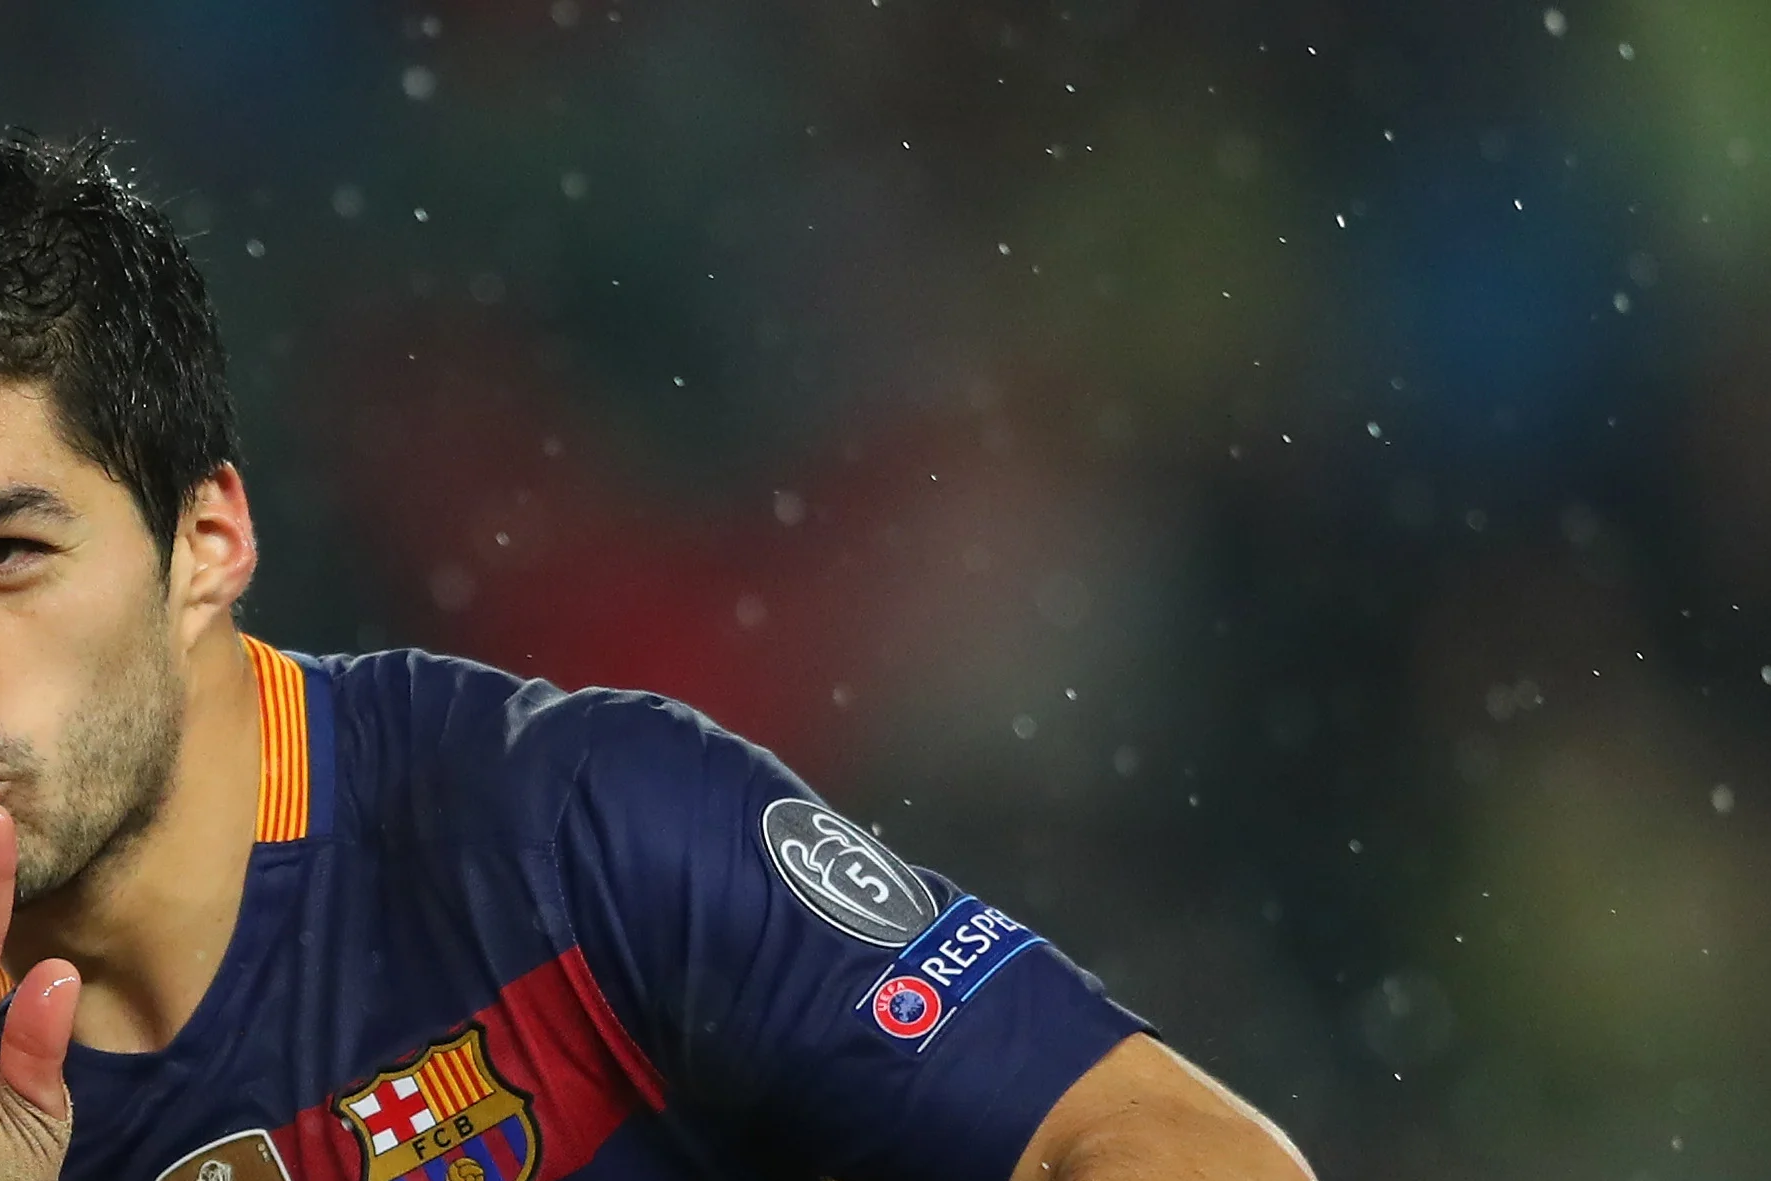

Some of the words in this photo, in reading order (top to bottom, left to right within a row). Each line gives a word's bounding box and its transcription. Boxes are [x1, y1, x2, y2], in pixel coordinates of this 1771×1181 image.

[845, 862, 889, 904] 5
[920, 908, 1027, 987] RESPE
[877, 981, 906, 1012] UEFA
